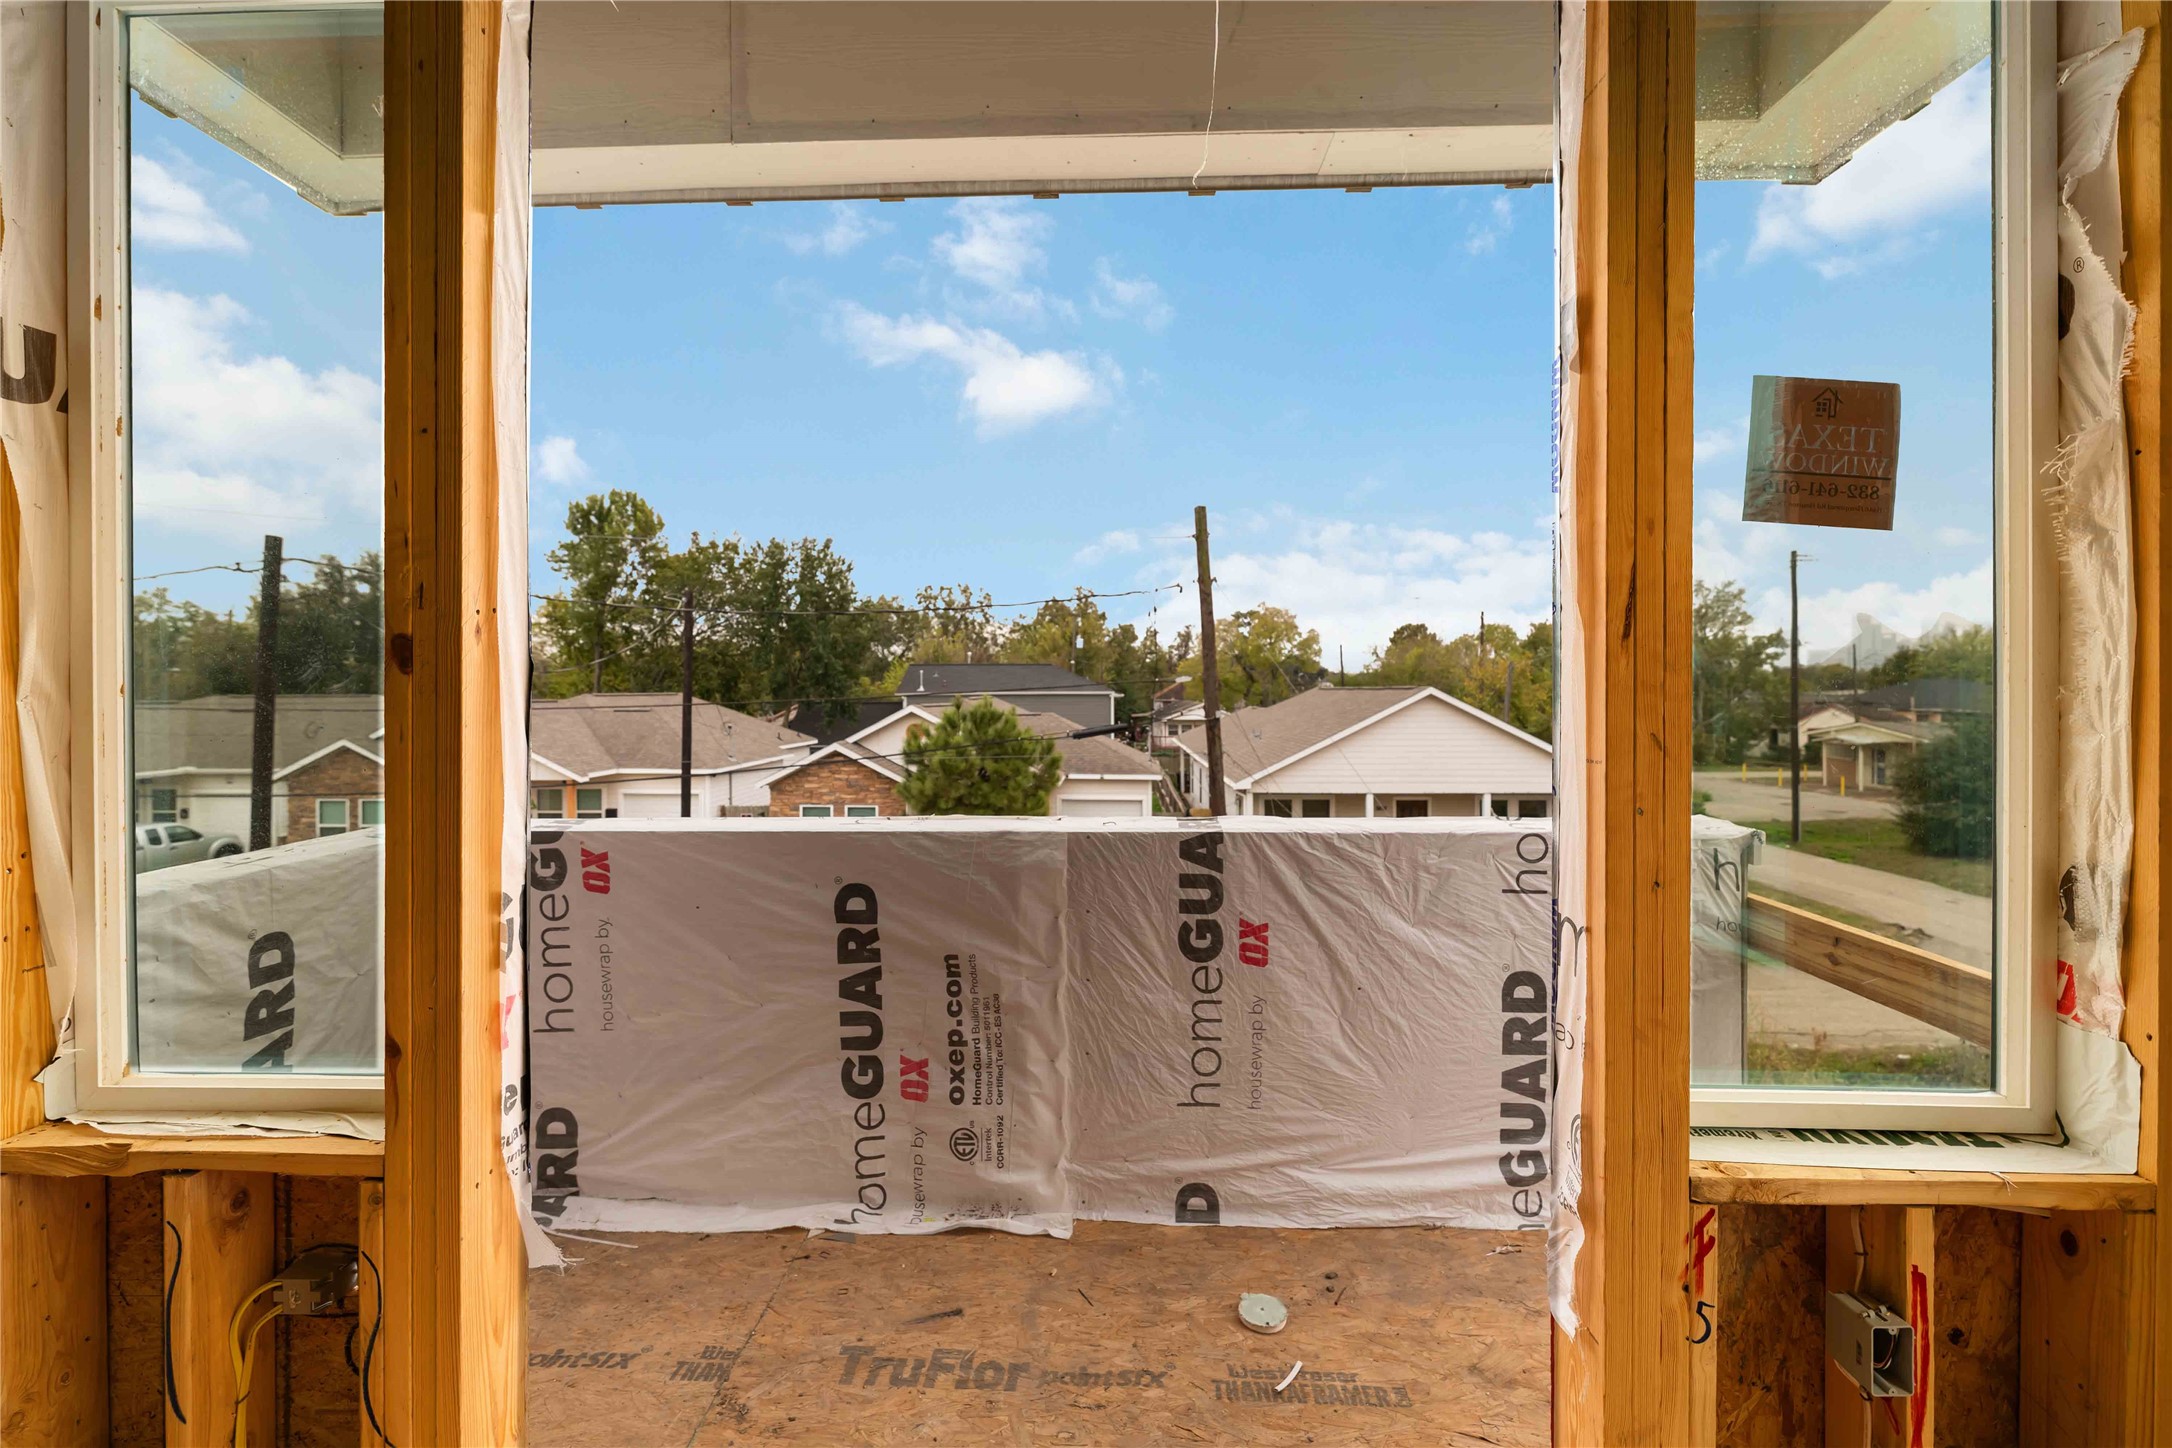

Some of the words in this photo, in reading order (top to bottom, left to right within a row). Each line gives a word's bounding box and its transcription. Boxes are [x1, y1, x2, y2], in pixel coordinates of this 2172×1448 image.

[580, 847, 611, 894] OX
[1239, 917, 1269, 968] OX
[600, 944, 614, 1031] housewrap
[968, 953, 979, 994] Products
[971, 998, 981, 1035] Building
[1248, 995, 1267, 1014] by
[944, 954, 968, 1106] oxep.com
[983, 1033, 993, 1069] Number:
[900, 1054, 929, 1103] OX
[972, 1037, 982, 1106] HomeGuard
[994, 1049, 1003, 1063] To:
[1247, 1019, 1267, 1110] housewrap
[985, 1072, 994, 1106] Control
[995, 1064, 1004, 1106] Certified
[1499, 971, 1548, 1231] eGUARD
[911, 1127, 928, 1148] by
[984, 1127, 992, 1162] Intertek
[996, 1115, 1004, 1169] CCRR-1092
[531, 1107, 580, 1227] ARD
[838, 1345, 1031, 1392] TruFlor
